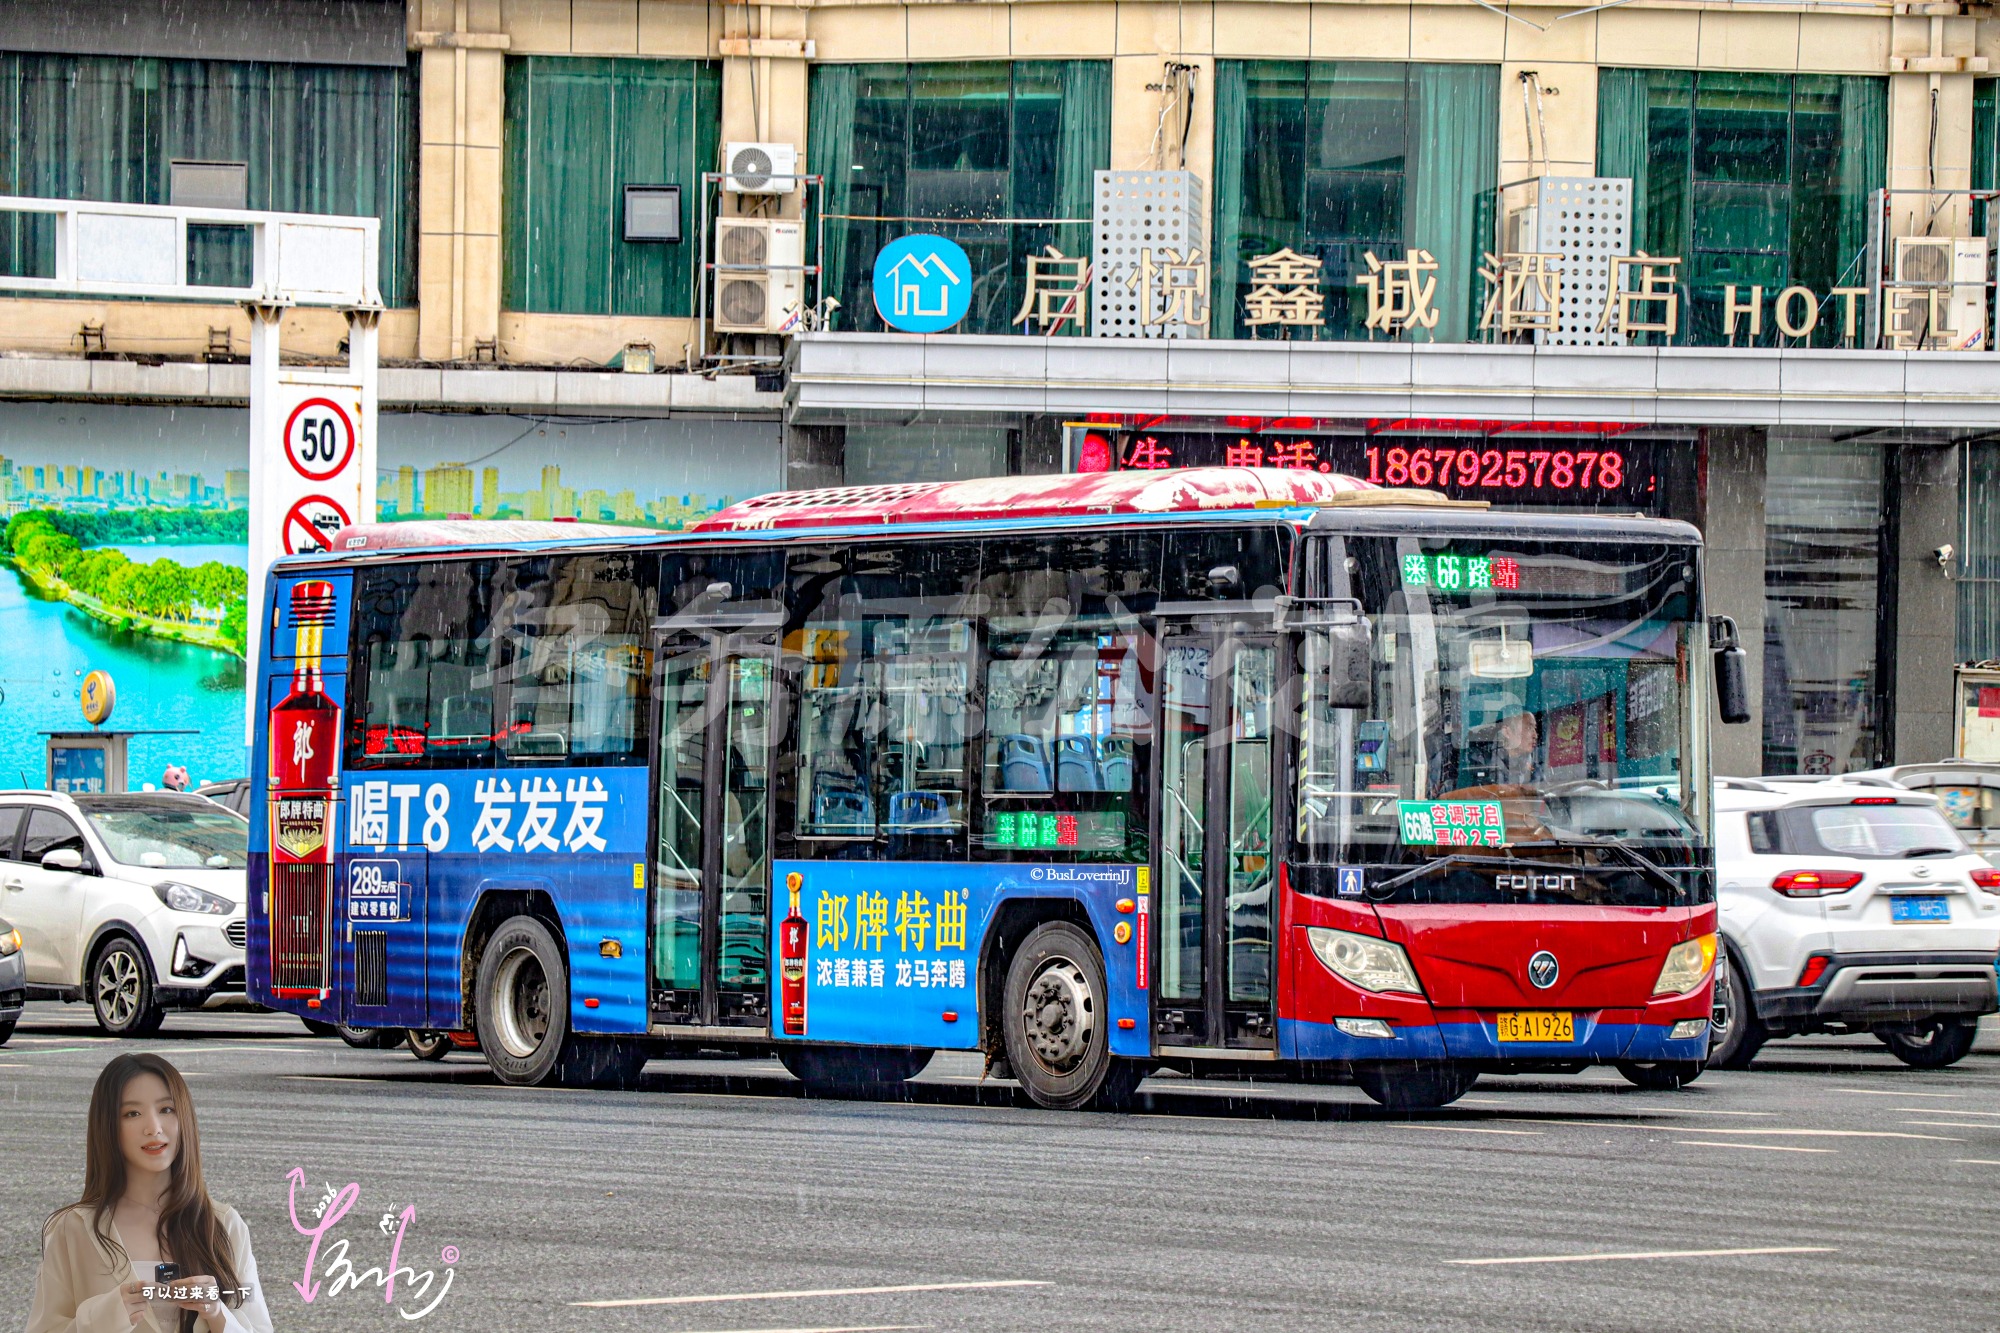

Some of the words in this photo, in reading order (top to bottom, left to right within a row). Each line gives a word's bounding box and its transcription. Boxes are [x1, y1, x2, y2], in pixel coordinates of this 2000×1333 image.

[1012, 245, 1682, 336] 启悦鑫诚酒店
[1723, 284, 1958, 338] HOTEL
[301, 418, 336, 462] 50
[1366, 447, 1622, 489] 18679257878
[280, 800, 324, 820] 郎牌特曲
[351, 780, 450, 853] 喝T8
[471, 776, 608, 853] 发发发
[1430, 804, 1500, 827] 空调开启
[1496, 874, 1576, 891] FOTON
[350, 901, 397, 917] 建议零售价
[817, 890, 967, 952] 郎牌特曲
[817, 958, 885, 987] 浓酱兼香
[896, 958, 966, 988] 龙马奔腾
